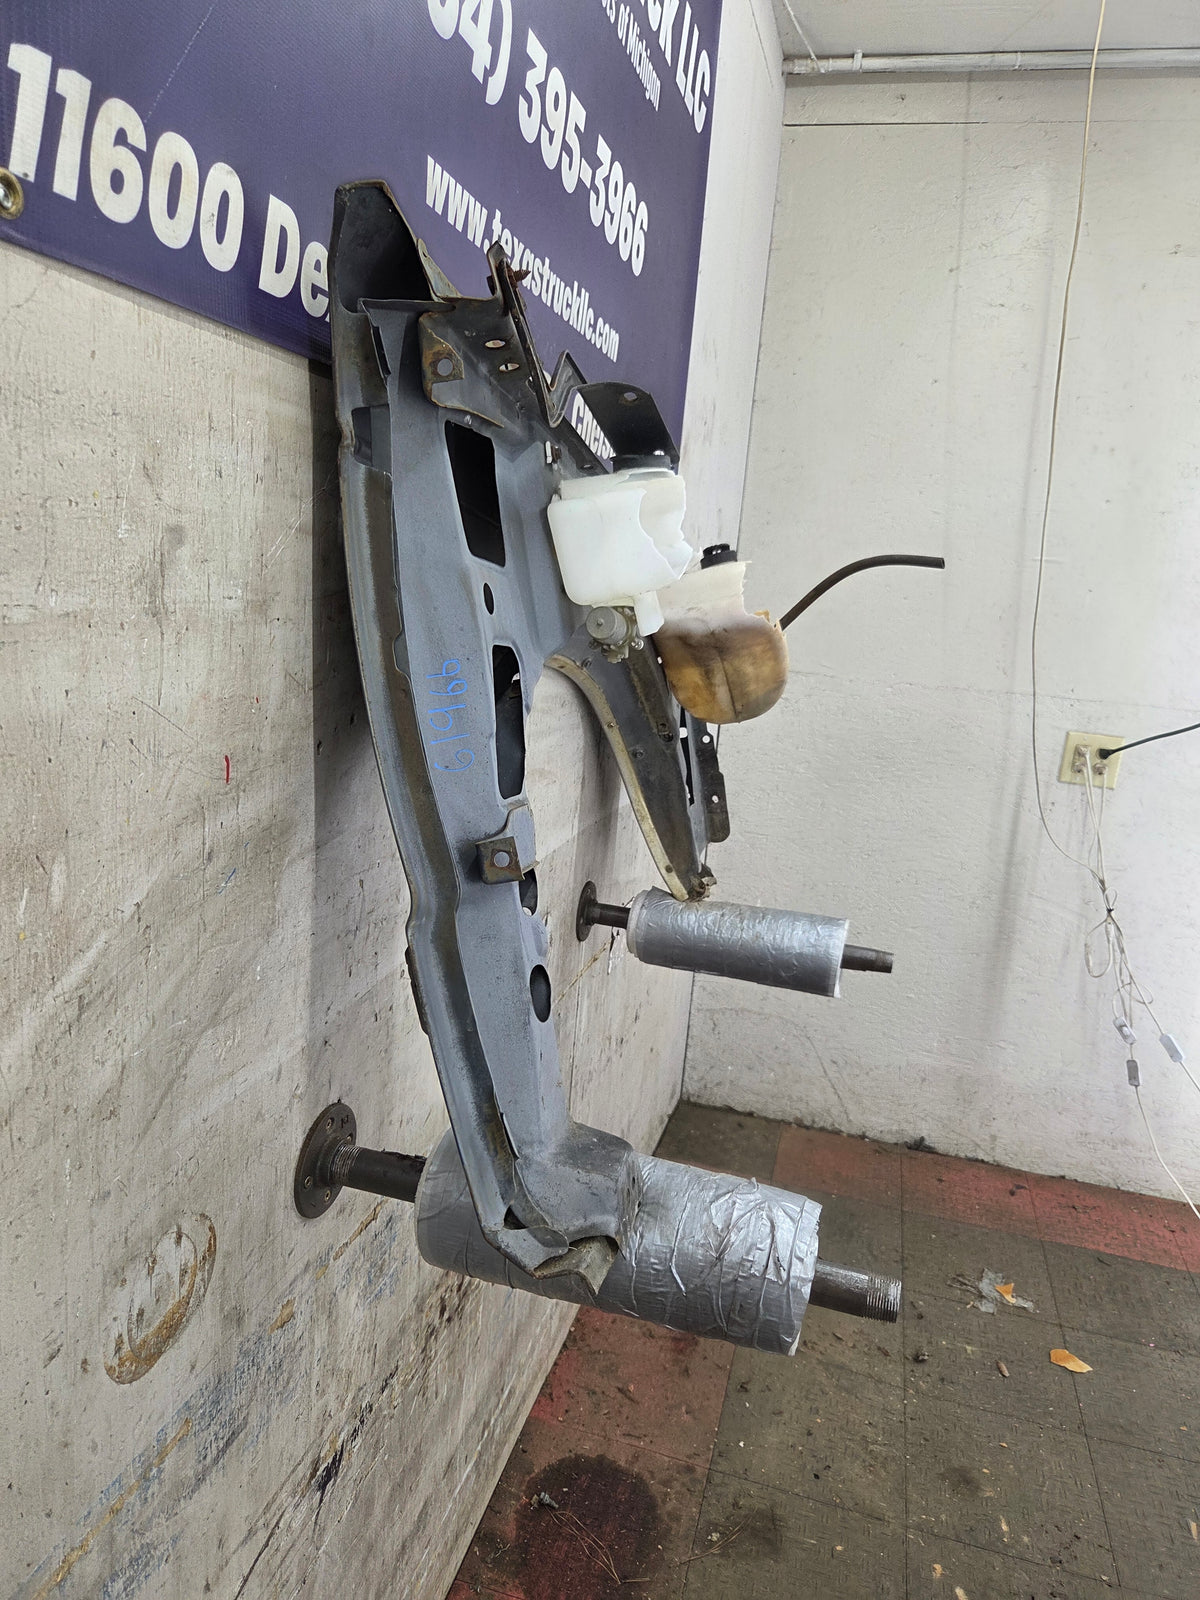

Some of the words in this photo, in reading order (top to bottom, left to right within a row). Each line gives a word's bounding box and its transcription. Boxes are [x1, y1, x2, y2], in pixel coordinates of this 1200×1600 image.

[627, 12, 661, 112] Michigan
[675, 1, 711, 134] LLC
[7, 42, 244, 272] 11600
[258, 193, 330, 322] De
[518, 27, 649, 277] 395-3966
[425, 154, 620, 363] www.texastruckllc.com
[426, 658, 475, 772] 61966
